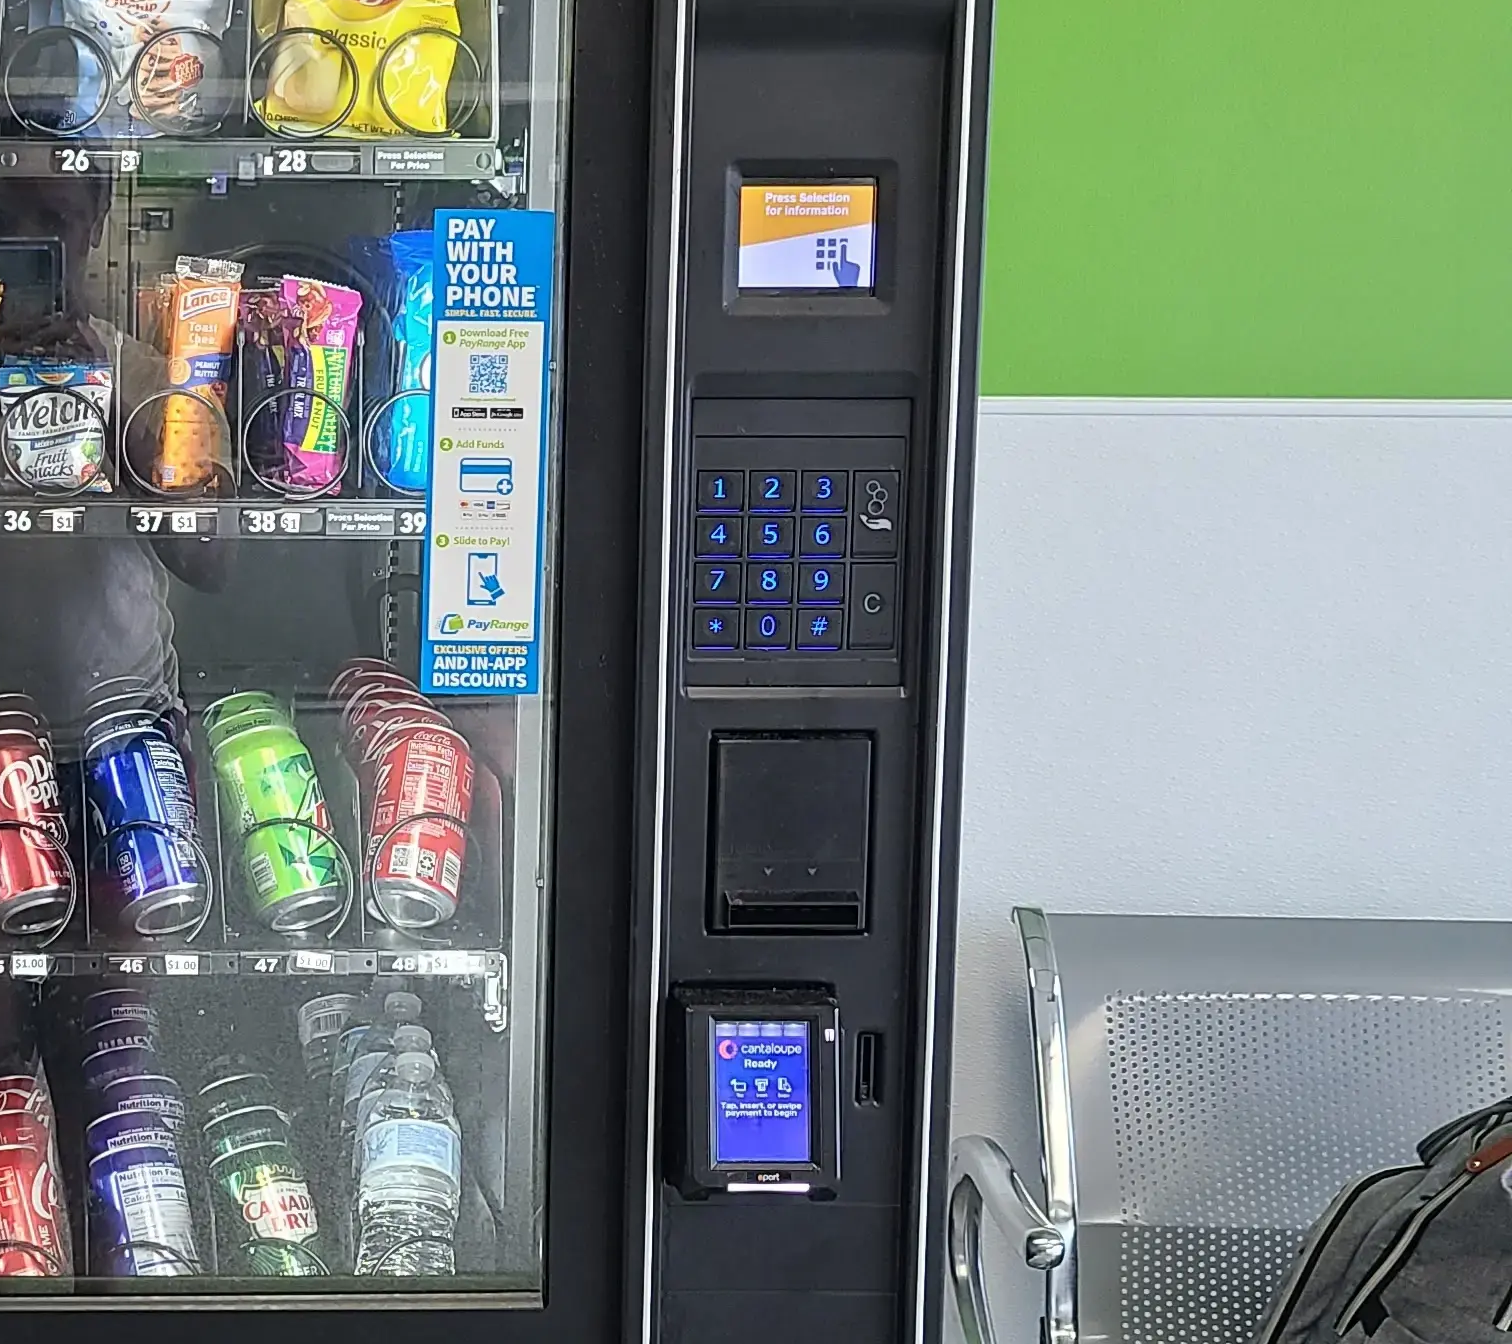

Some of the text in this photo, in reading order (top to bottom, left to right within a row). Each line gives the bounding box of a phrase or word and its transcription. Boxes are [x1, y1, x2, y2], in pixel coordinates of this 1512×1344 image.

[319, 30, 387, 50] Classic
[61, 150, 139, 171] 26 $1
[279, 150, 307, 172] 28
[765, 192, 850, 203] Press Selection
[765, 205, 782, 216] for
[448, 218, 496, 239] PAY
[446, 242, 514, 262] WITH
[445, 264, 517, 284] YOUR
[183, 291, 228, 312] Lance
[446, 286, 536, 307] PHONE
[459, 329, 529, 338] Download Free
[459, 339, 526, 349] PayRange App
[5, 391, 105, 431] Welch's
[456, 440, 505, 449] Add Funds
[34, 447, 69, 468] Fruit
[24, 463, 75, 482] Snacks
[713, 478, 726, 499] 1
[764, 477, 780, 499] 2
[816, 477, 832, 499] 3
[4, 510, 73, 531] 36 $1
[136, 511, 194, 532] 37 $1
[248, 511, 276, 533] 38
[399, 512, 426, 533] 39
[453, 536, 510, 546] Slide to Pay!
[710, 524, 727, 544] 4
[763, 524, 778, 544] 5
[815, 524, 830, 544] 6
[710, 570, 725, 590] 7
[761, 570, 777, 590] 8
[814, 570, 829, 590] 9
[864, 593, 881, 613] C
[467, 619, 529, 631] PayRange
[760, 615, 776, 636] 0
[433, 644, 528, 655] EXCLUSIVE OFFERS
[433, 657, 527, 670] AND IN-APP
[432, 672, 527, 688] DISCOUNTS
[29, 755, 55, 782] Dr
[434, 764, 450, 777] 140
[15, 958, 44, 969] $1.00
[119, 959, 143, 974] 46
[254, 958, 279, 972] 47
[391, 957, 415, 972] 48
[741, 1042, 802, 1056] cantaloupe
[744, 1059, 777, 1071] Ready
[119, 1099, 162, 1111] Nutrition
[725, 1109, 798, 1119] payment to begin
[777, 1102, 802, 1111] swipe
[109, 1133, 153, 1148] Nutrition
